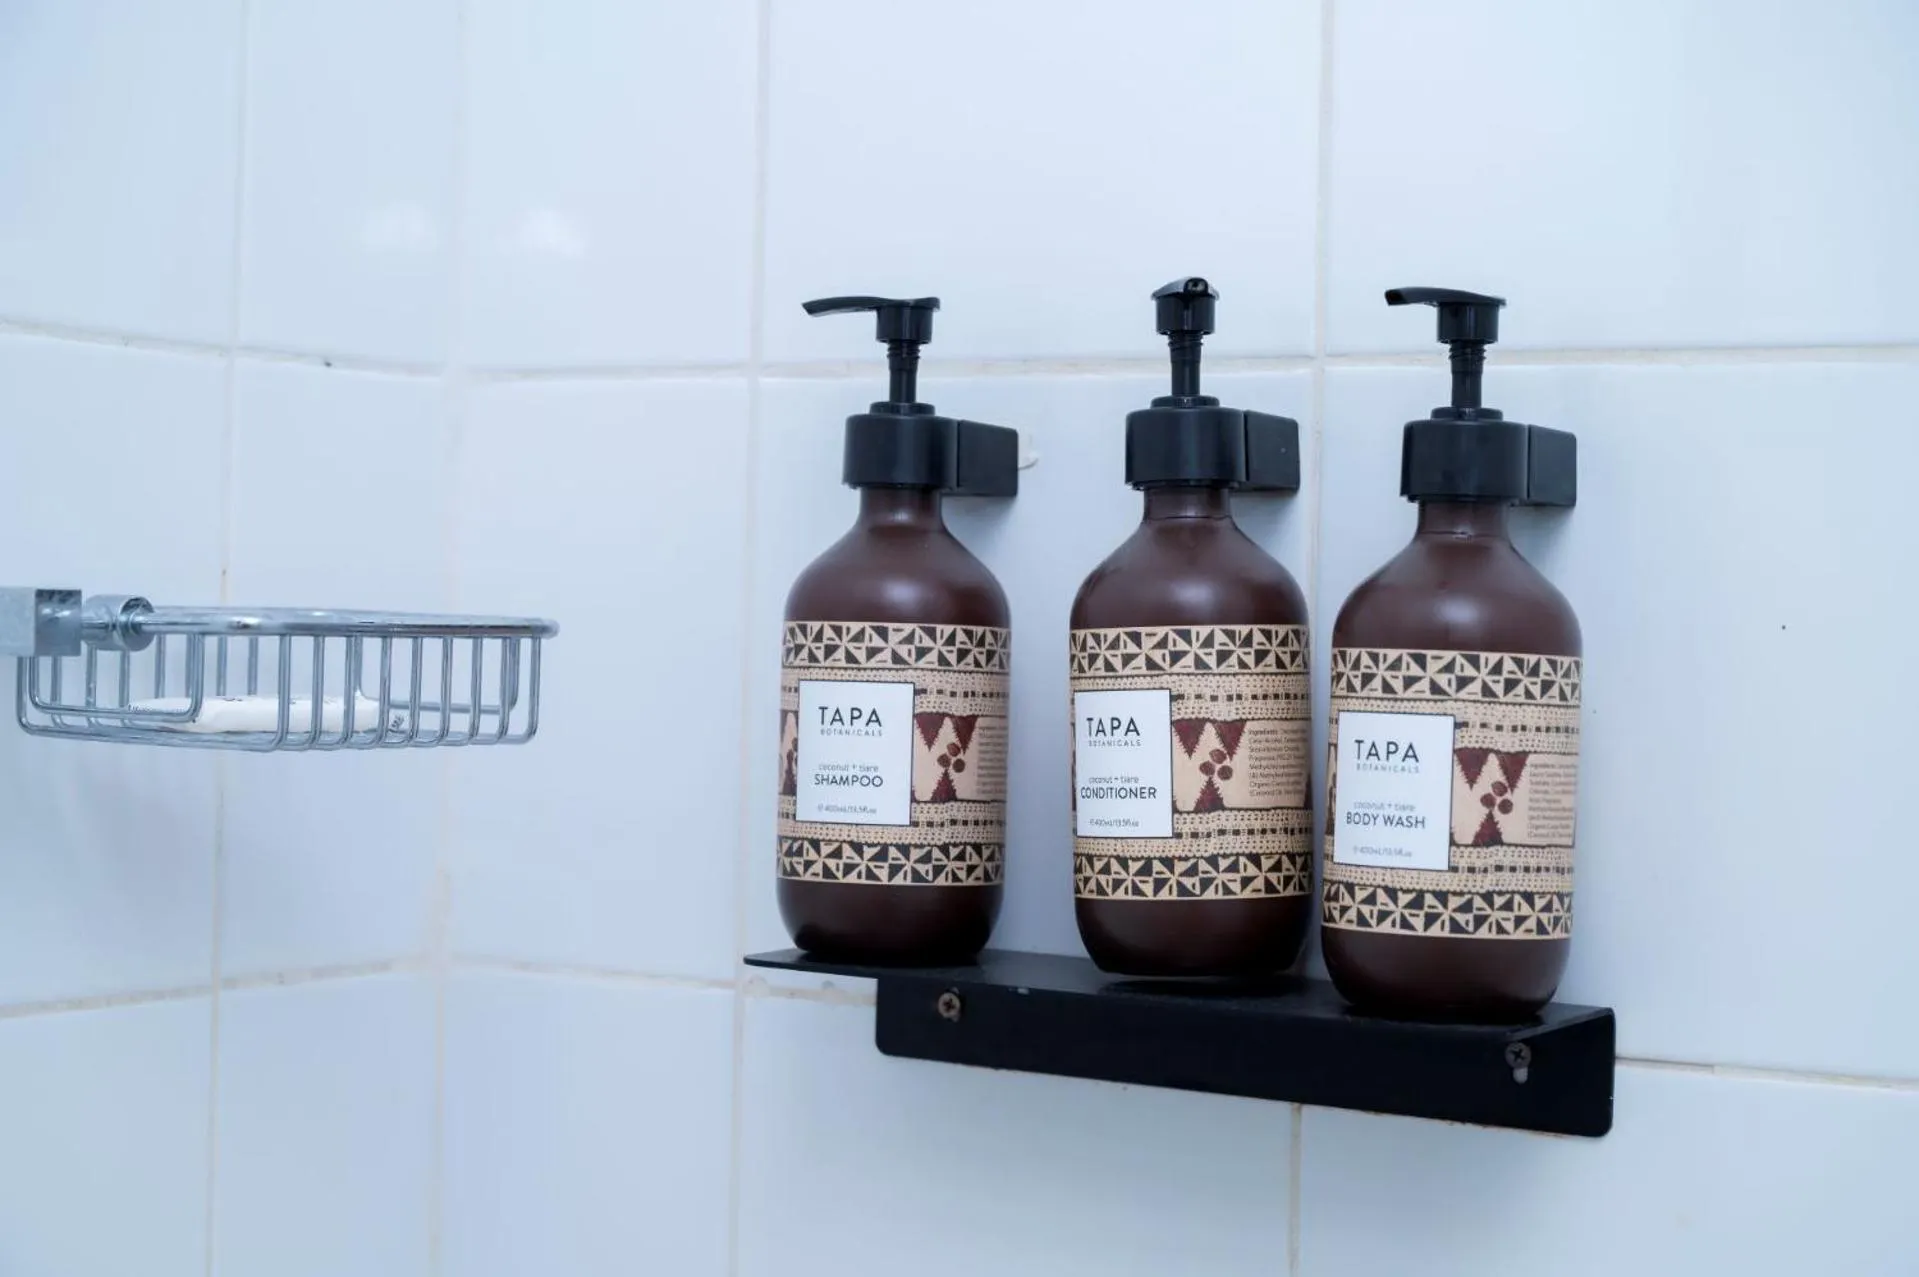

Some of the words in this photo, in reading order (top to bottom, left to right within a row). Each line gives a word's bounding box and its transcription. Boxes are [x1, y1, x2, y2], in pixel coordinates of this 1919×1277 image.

[818, 706, 882, 727] TAPA
[820, 729, 883, 737] BOTANICALS
[1086, 716, 1141, 737] TAPA
[1088, 739, 1142, 747] BOTANICALS
[1354, 739, 1420, 763] TAPA
[1356, 763, 1420, 774] BOTANICALS
[814, 773, 884, 788] SHAMPOO
[1080, 786, 1158, 800] CONDITIONER
[1346, 812, 1380, 826] BODY
[1382, 814, 1426, 829] WASH
